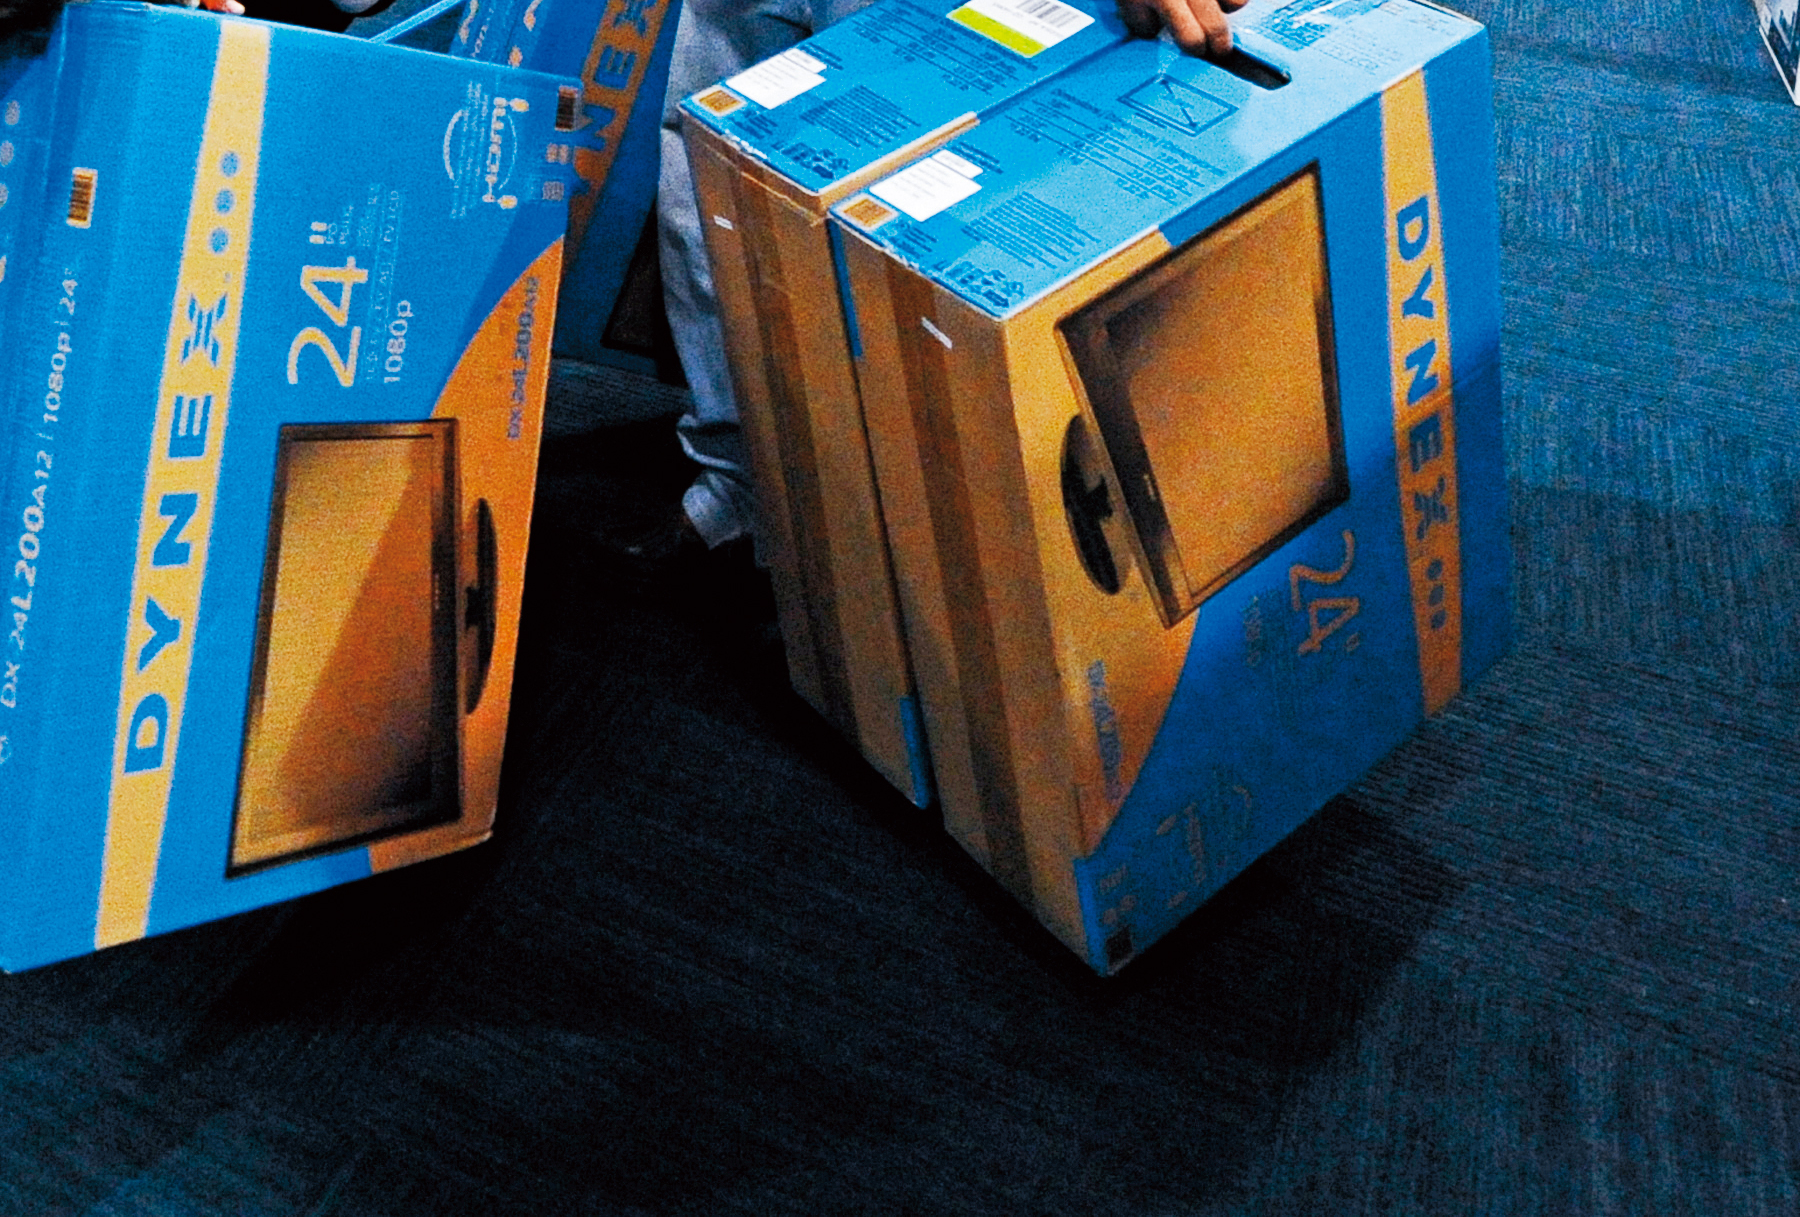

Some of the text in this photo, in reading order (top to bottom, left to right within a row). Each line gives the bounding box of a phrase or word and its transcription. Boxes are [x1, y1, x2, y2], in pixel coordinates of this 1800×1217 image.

[43, 331, 74, 426] 1080p
[384, 299, 414, 384] 1080p
[1396, 194, 1449, 542] DYNEX
[122, 291, 230, 777] DYNEX
